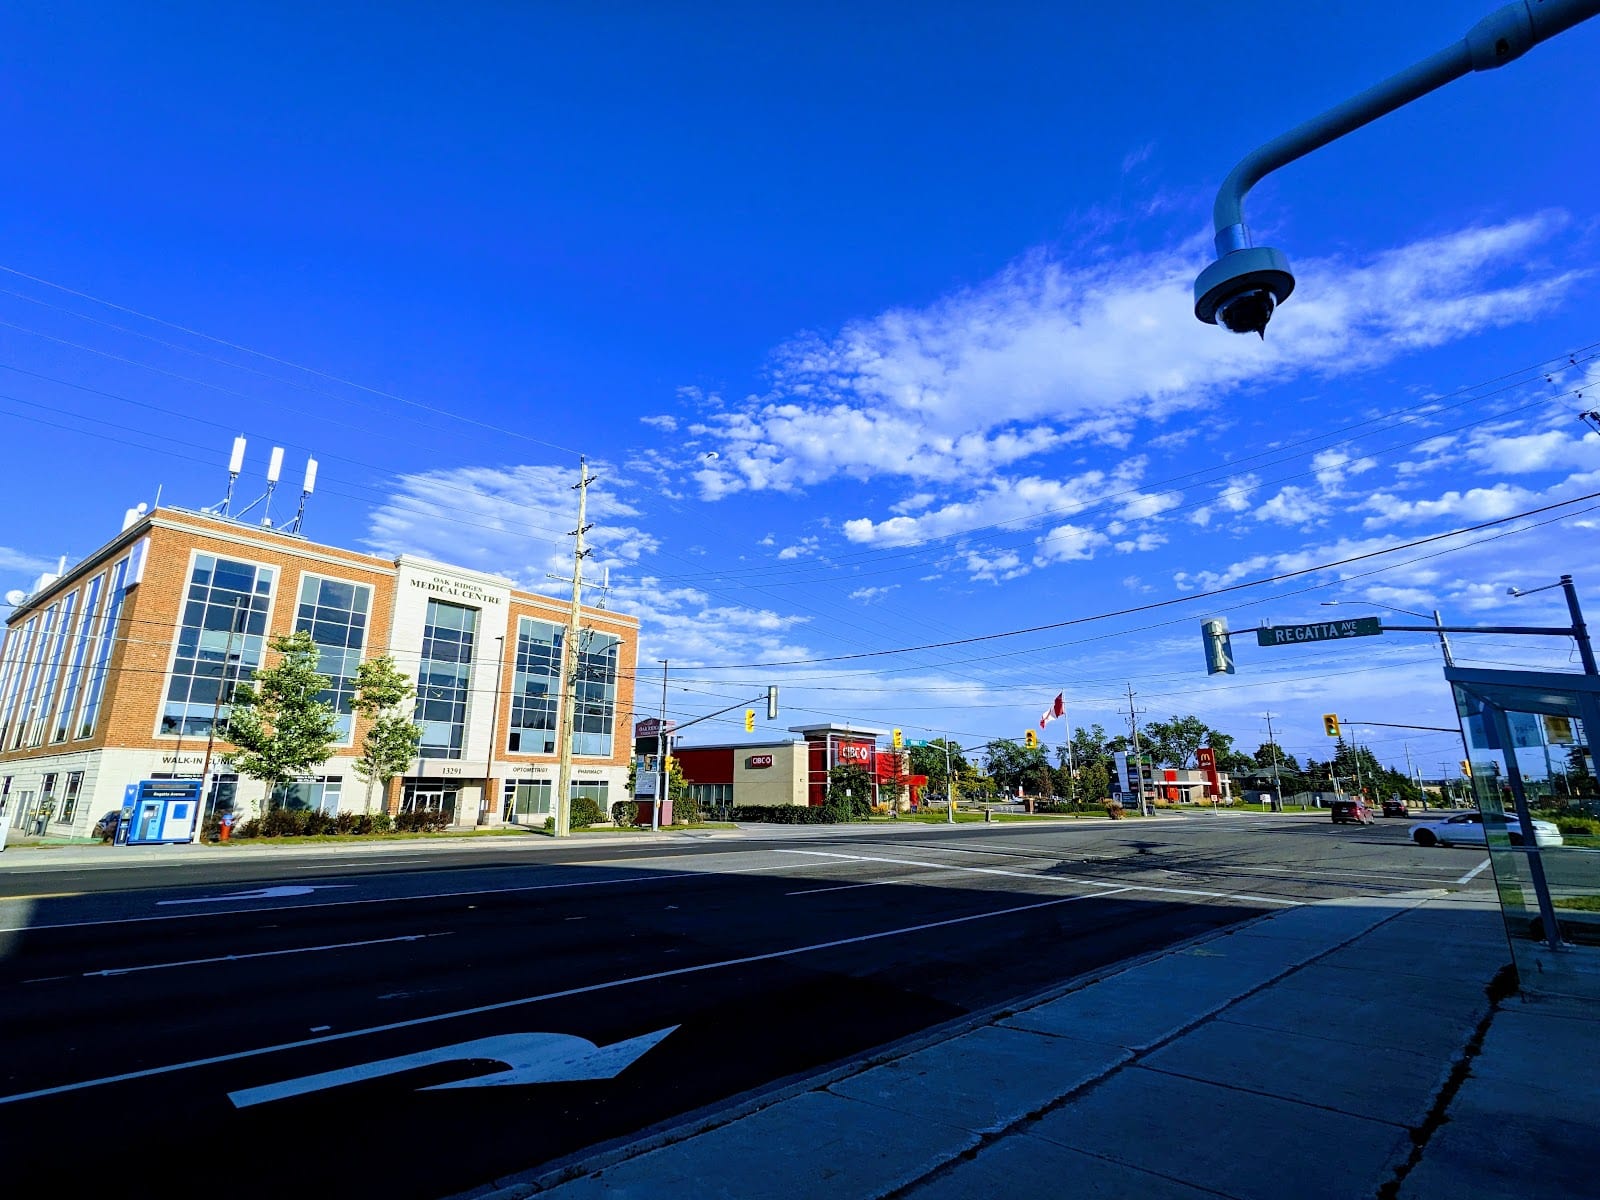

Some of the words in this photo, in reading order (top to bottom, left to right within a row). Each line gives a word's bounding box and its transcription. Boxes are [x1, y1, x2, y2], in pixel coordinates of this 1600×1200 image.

[433, 577, 450, 585] OAK
[454, 580, 483, 592] RIDGES
[410, 578, 460, 596] MEDICAL
[462, 590, 502, 605] CENTRE
[1275, 623, 1339, 643] REGATTA
[1341, 621, 1358, 631] AVE
[842, 747, 860, 759] CIBC
[162, 756, 203, 765] WALK-IN
[442, 767, 462, 775] 13291
